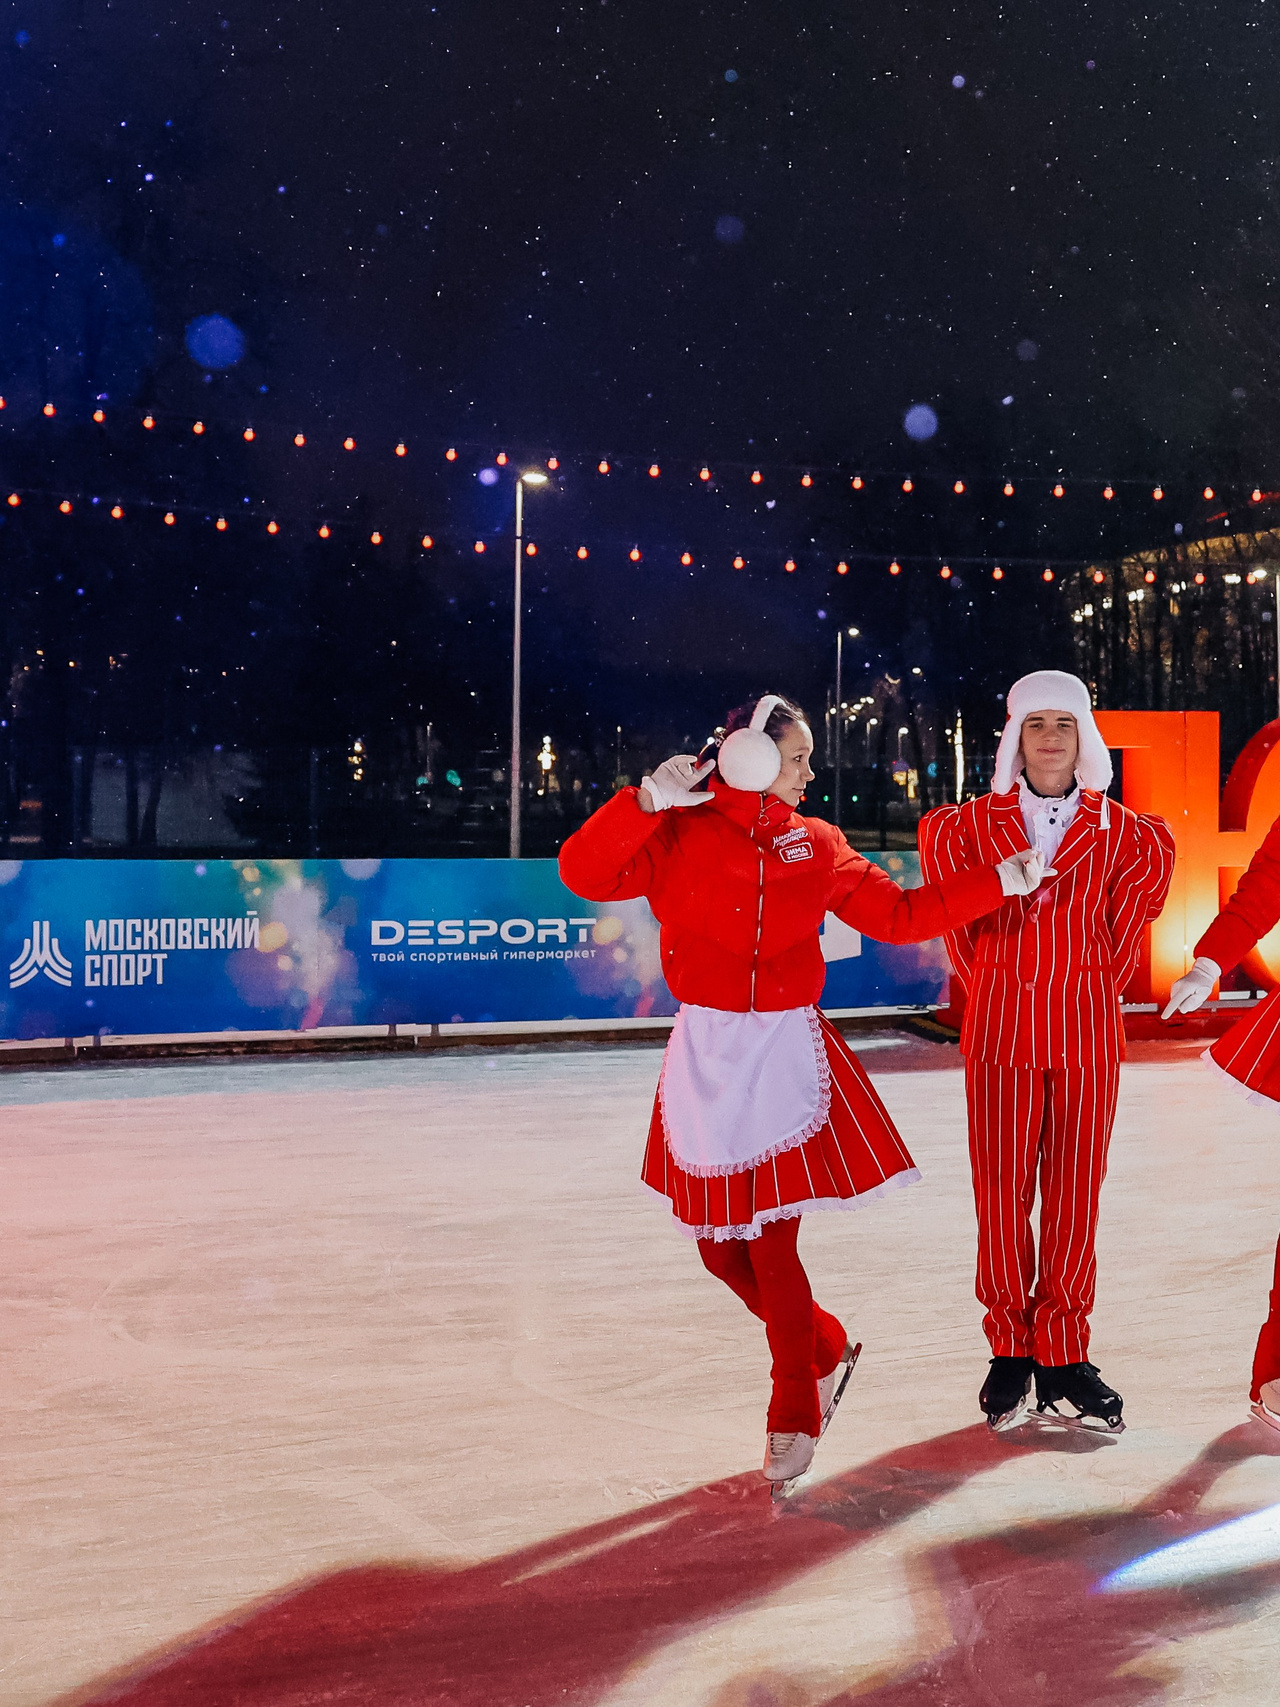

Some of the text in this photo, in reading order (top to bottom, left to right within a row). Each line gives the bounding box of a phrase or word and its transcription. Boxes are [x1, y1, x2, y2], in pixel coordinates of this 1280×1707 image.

[785, 846, 808, 857] ЗИМА
[85, 910, 260, 951] МОСКОВСКИЙ
[371, 918, 597, 946] DESPORT
[85, 953, 168, 987] СПОРТ
[371, 949, 596, 963] твой спортивный гипермаркет
